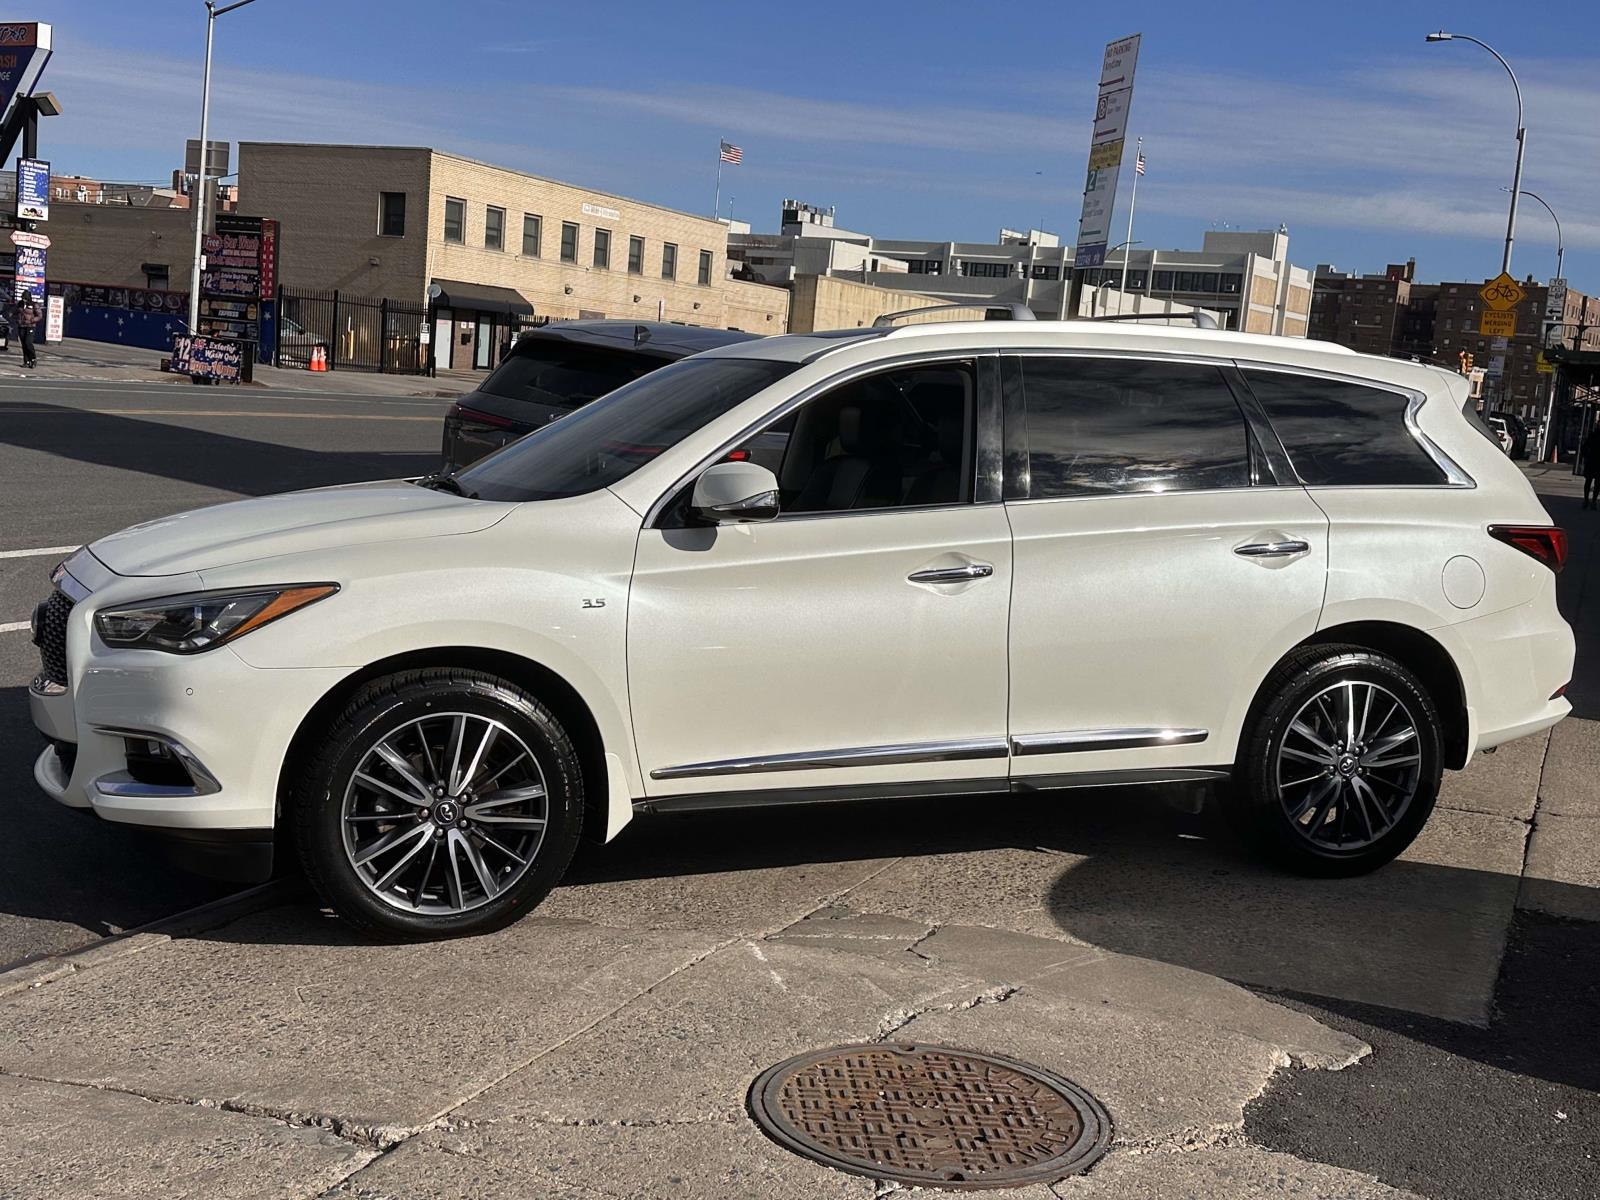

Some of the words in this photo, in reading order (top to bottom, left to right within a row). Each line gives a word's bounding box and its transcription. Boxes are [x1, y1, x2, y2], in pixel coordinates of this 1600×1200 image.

[1484, 311, 1514, 319] CYCLISTS
[1484, 320, 1512, 328] MERGING
[209, 341, 236, 354] Exterior
